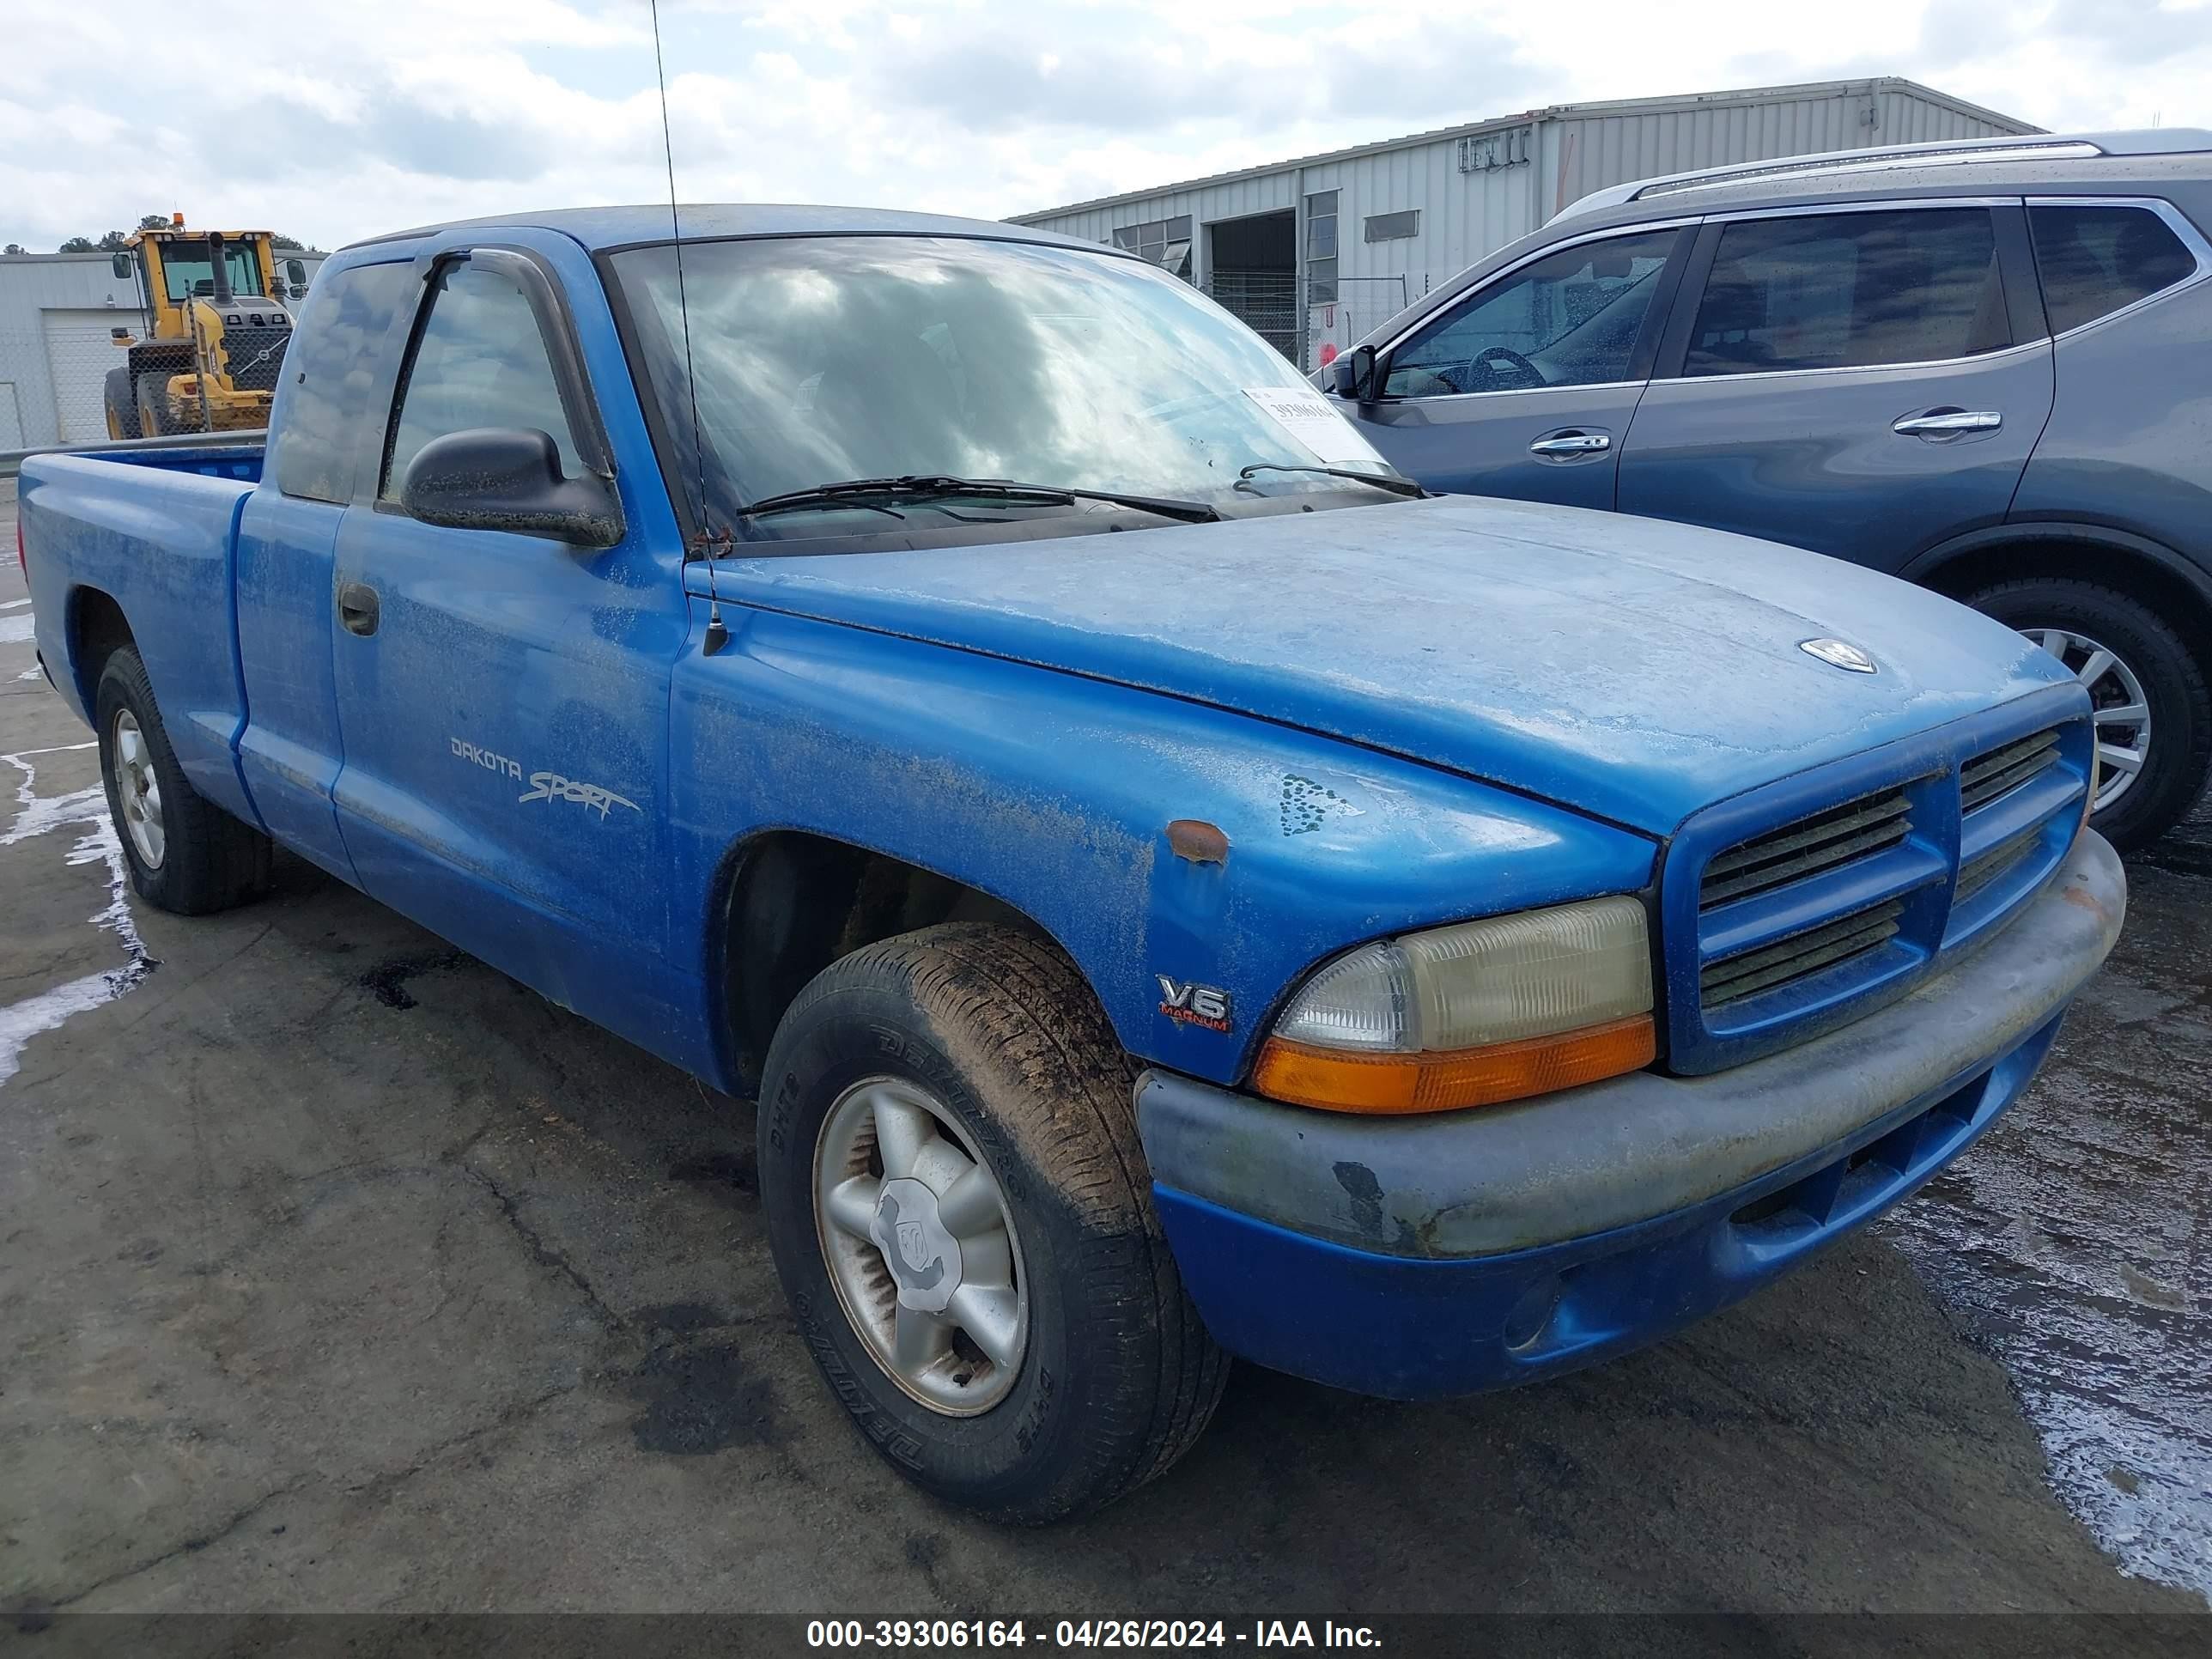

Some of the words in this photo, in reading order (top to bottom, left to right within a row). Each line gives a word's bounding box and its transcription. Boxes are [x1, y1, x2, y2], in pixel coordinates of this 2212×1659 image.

[1270, 404, 1337, 419] 39306164
[451, 737, 522, 781] DAKOTA
[519, 772, 642, 822] SPORT
[1155, 973, 1229, 1020] V6
[1159, 1001, 1228, 1031] MAGNUM
